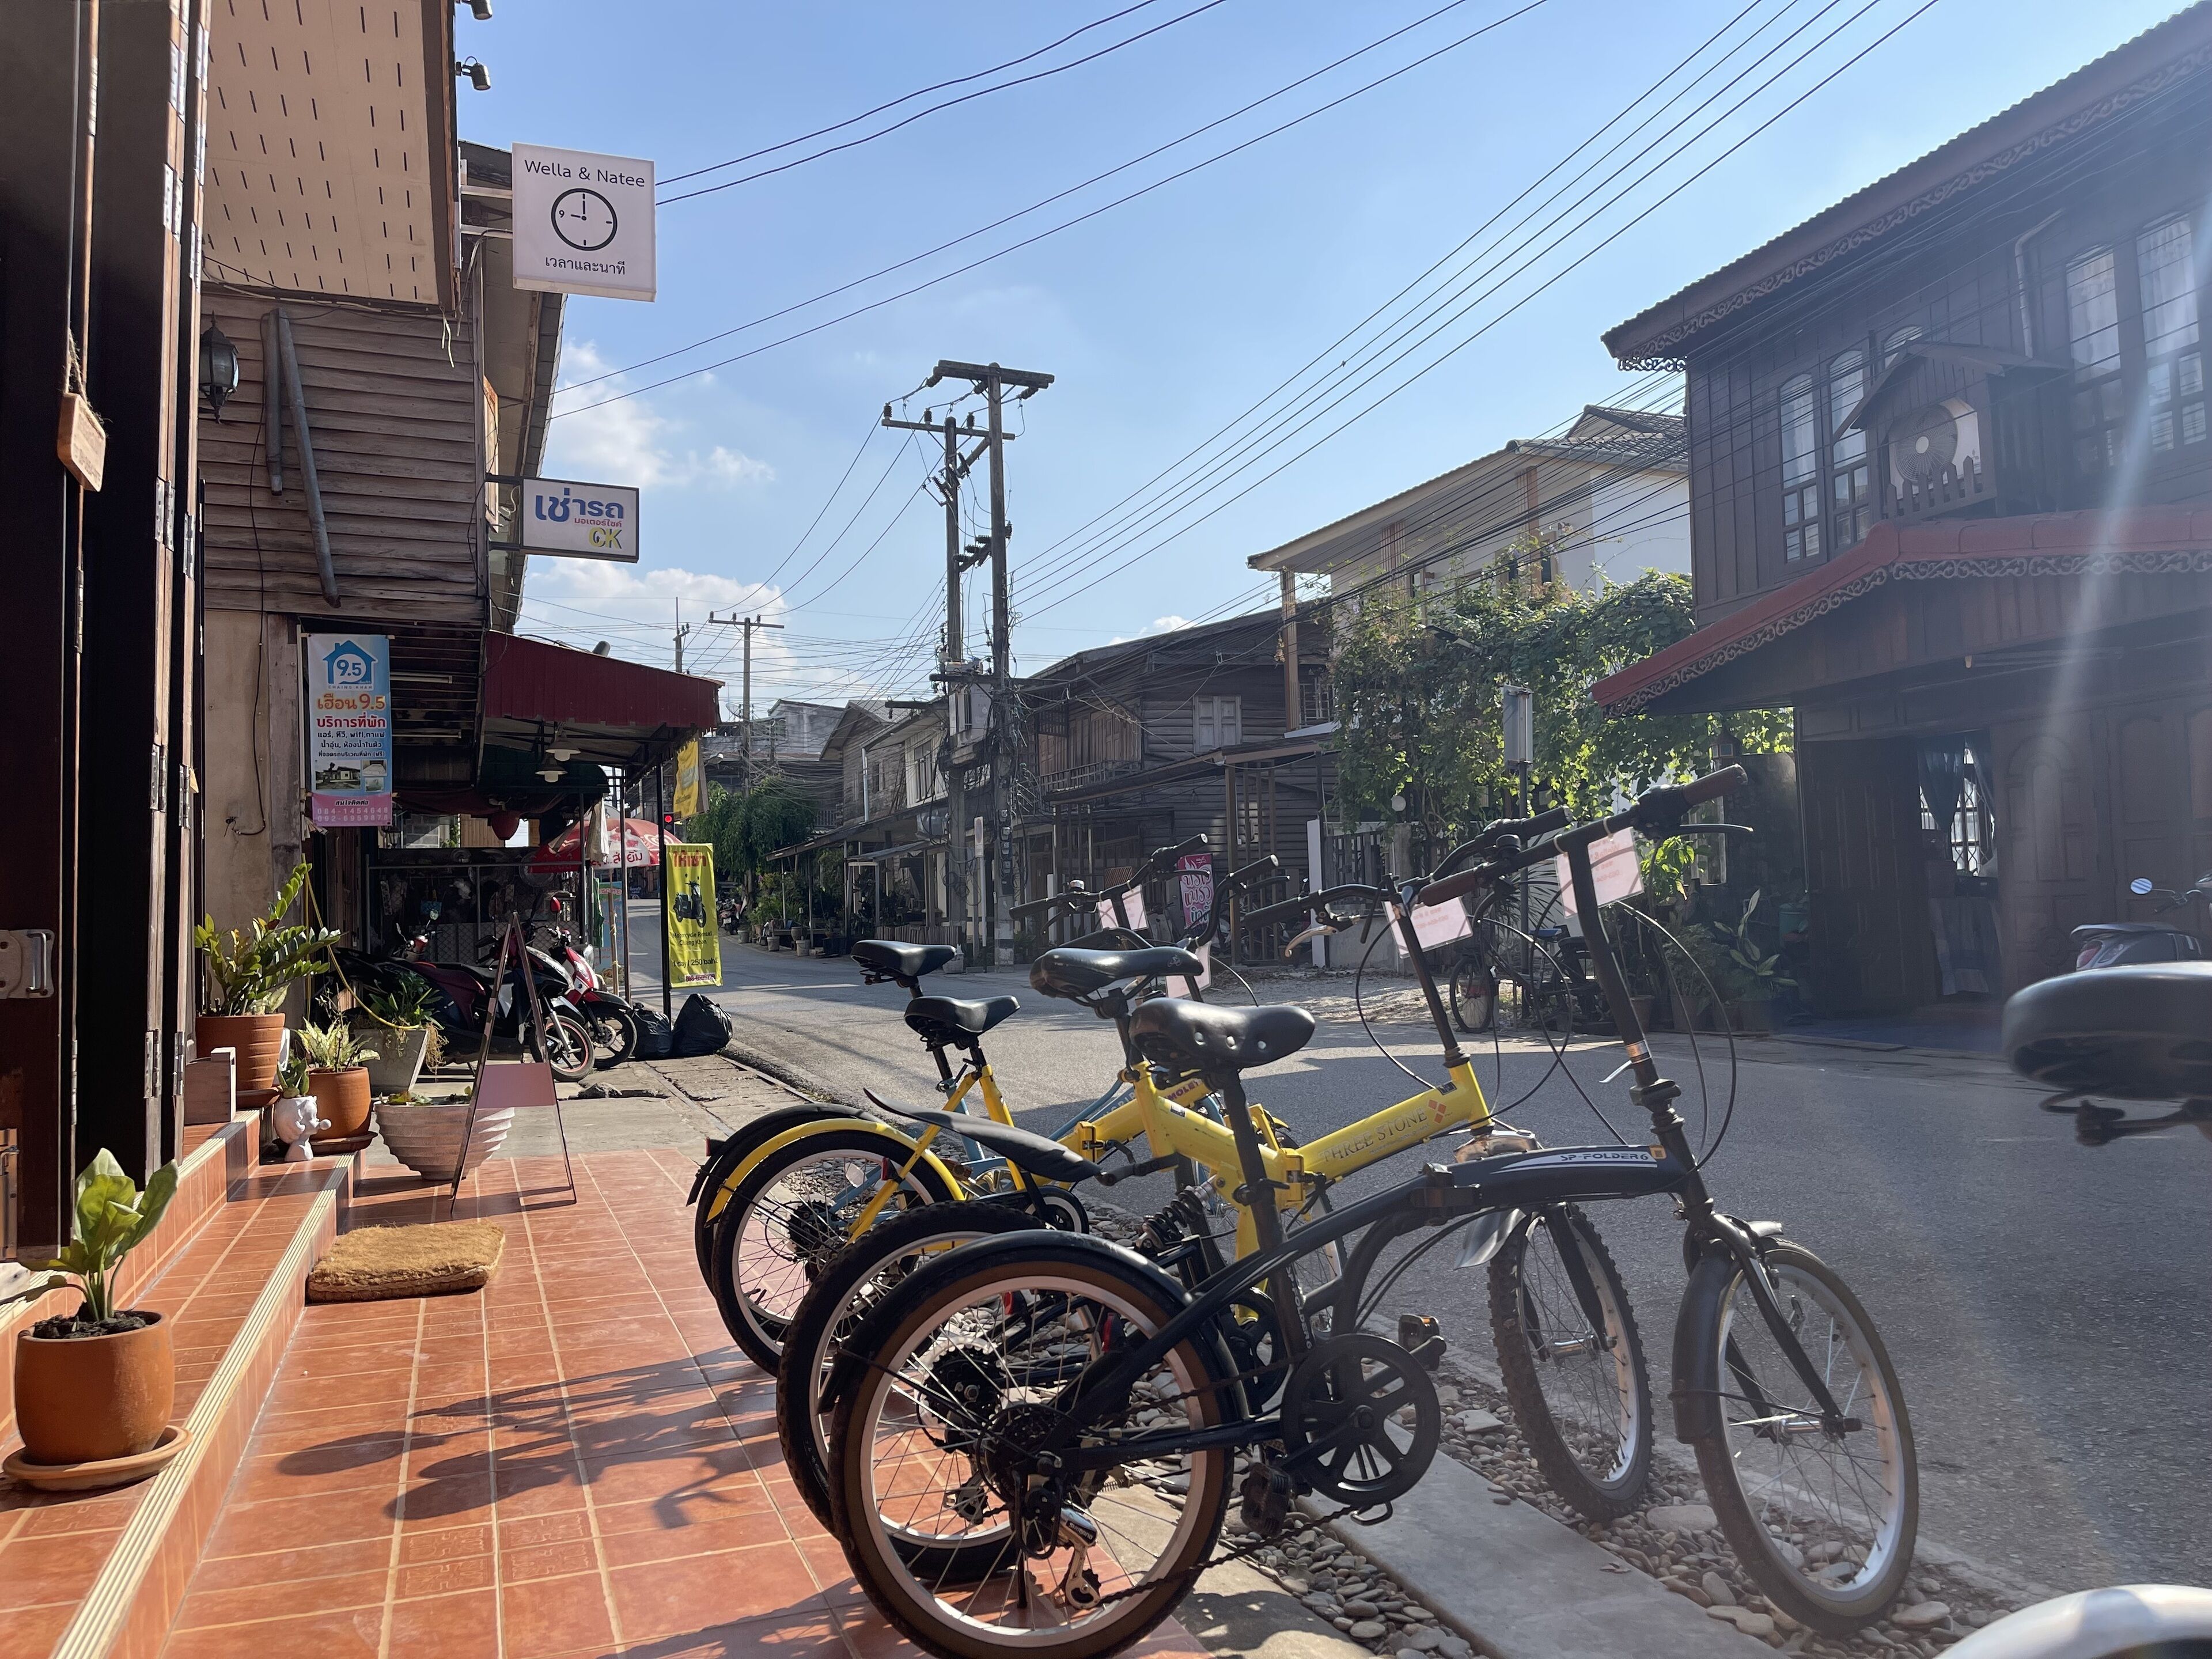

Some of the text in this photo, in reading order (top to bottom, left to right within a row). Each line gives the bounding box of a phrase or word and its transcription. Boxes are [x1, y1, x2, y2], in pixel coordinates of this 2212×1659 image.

[524, 159, 645, 187] Wella & Natee
[545, 256, 626, 275] เวลาและนาที
[535, 487, 624, 522] เช่ารถ
[336, 659, 362, 676] 9.5
[317, 693, 386, 710] เฮือน 9.5
[316, 712, 386, 728] บริการที่พัก
[673, 849, 706, 867] ให้เช่า
[1375, 1108, 1428, 1141] STONE
